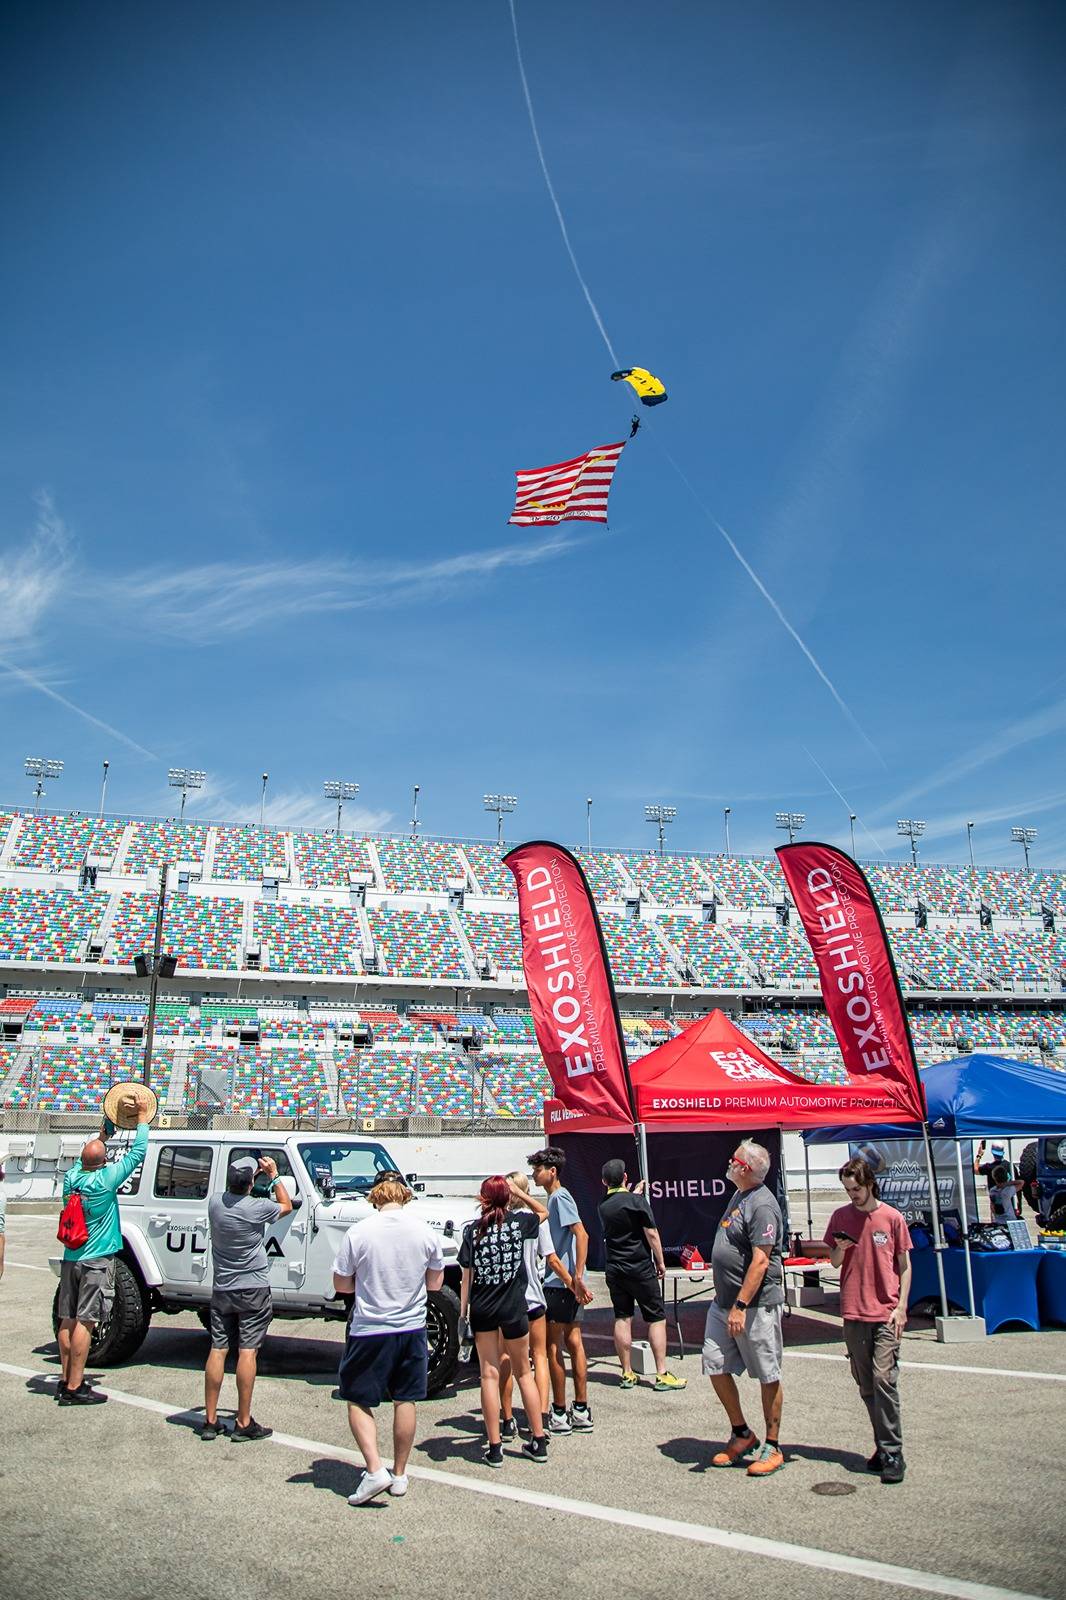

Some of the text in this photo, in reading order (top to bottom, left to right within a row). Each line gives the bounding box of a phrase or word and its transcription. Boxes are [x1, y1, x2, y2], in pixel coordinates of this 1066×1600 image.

[829, 861, 858, 930] PROTECTION
[527, 866, 595, 1078] EXOSHIELD
[550, 858, 607, 1072] PREMIUM AUTOMOTIVE PROTECTION
[807, 867, 890, 1072] EXOSHIELD
[857, 932, 884, 1010] AUTOMOTIVE
[652, 1097, 721, 1109] EXOSHIELD
[725, 1096, 777, 1108] PREMIUM
[779, 1096, 848, 1108] AUTOMOTIVE
[914, 1200, 928, 1208] OFF
[166, 1232, 286, 1257] ULA
